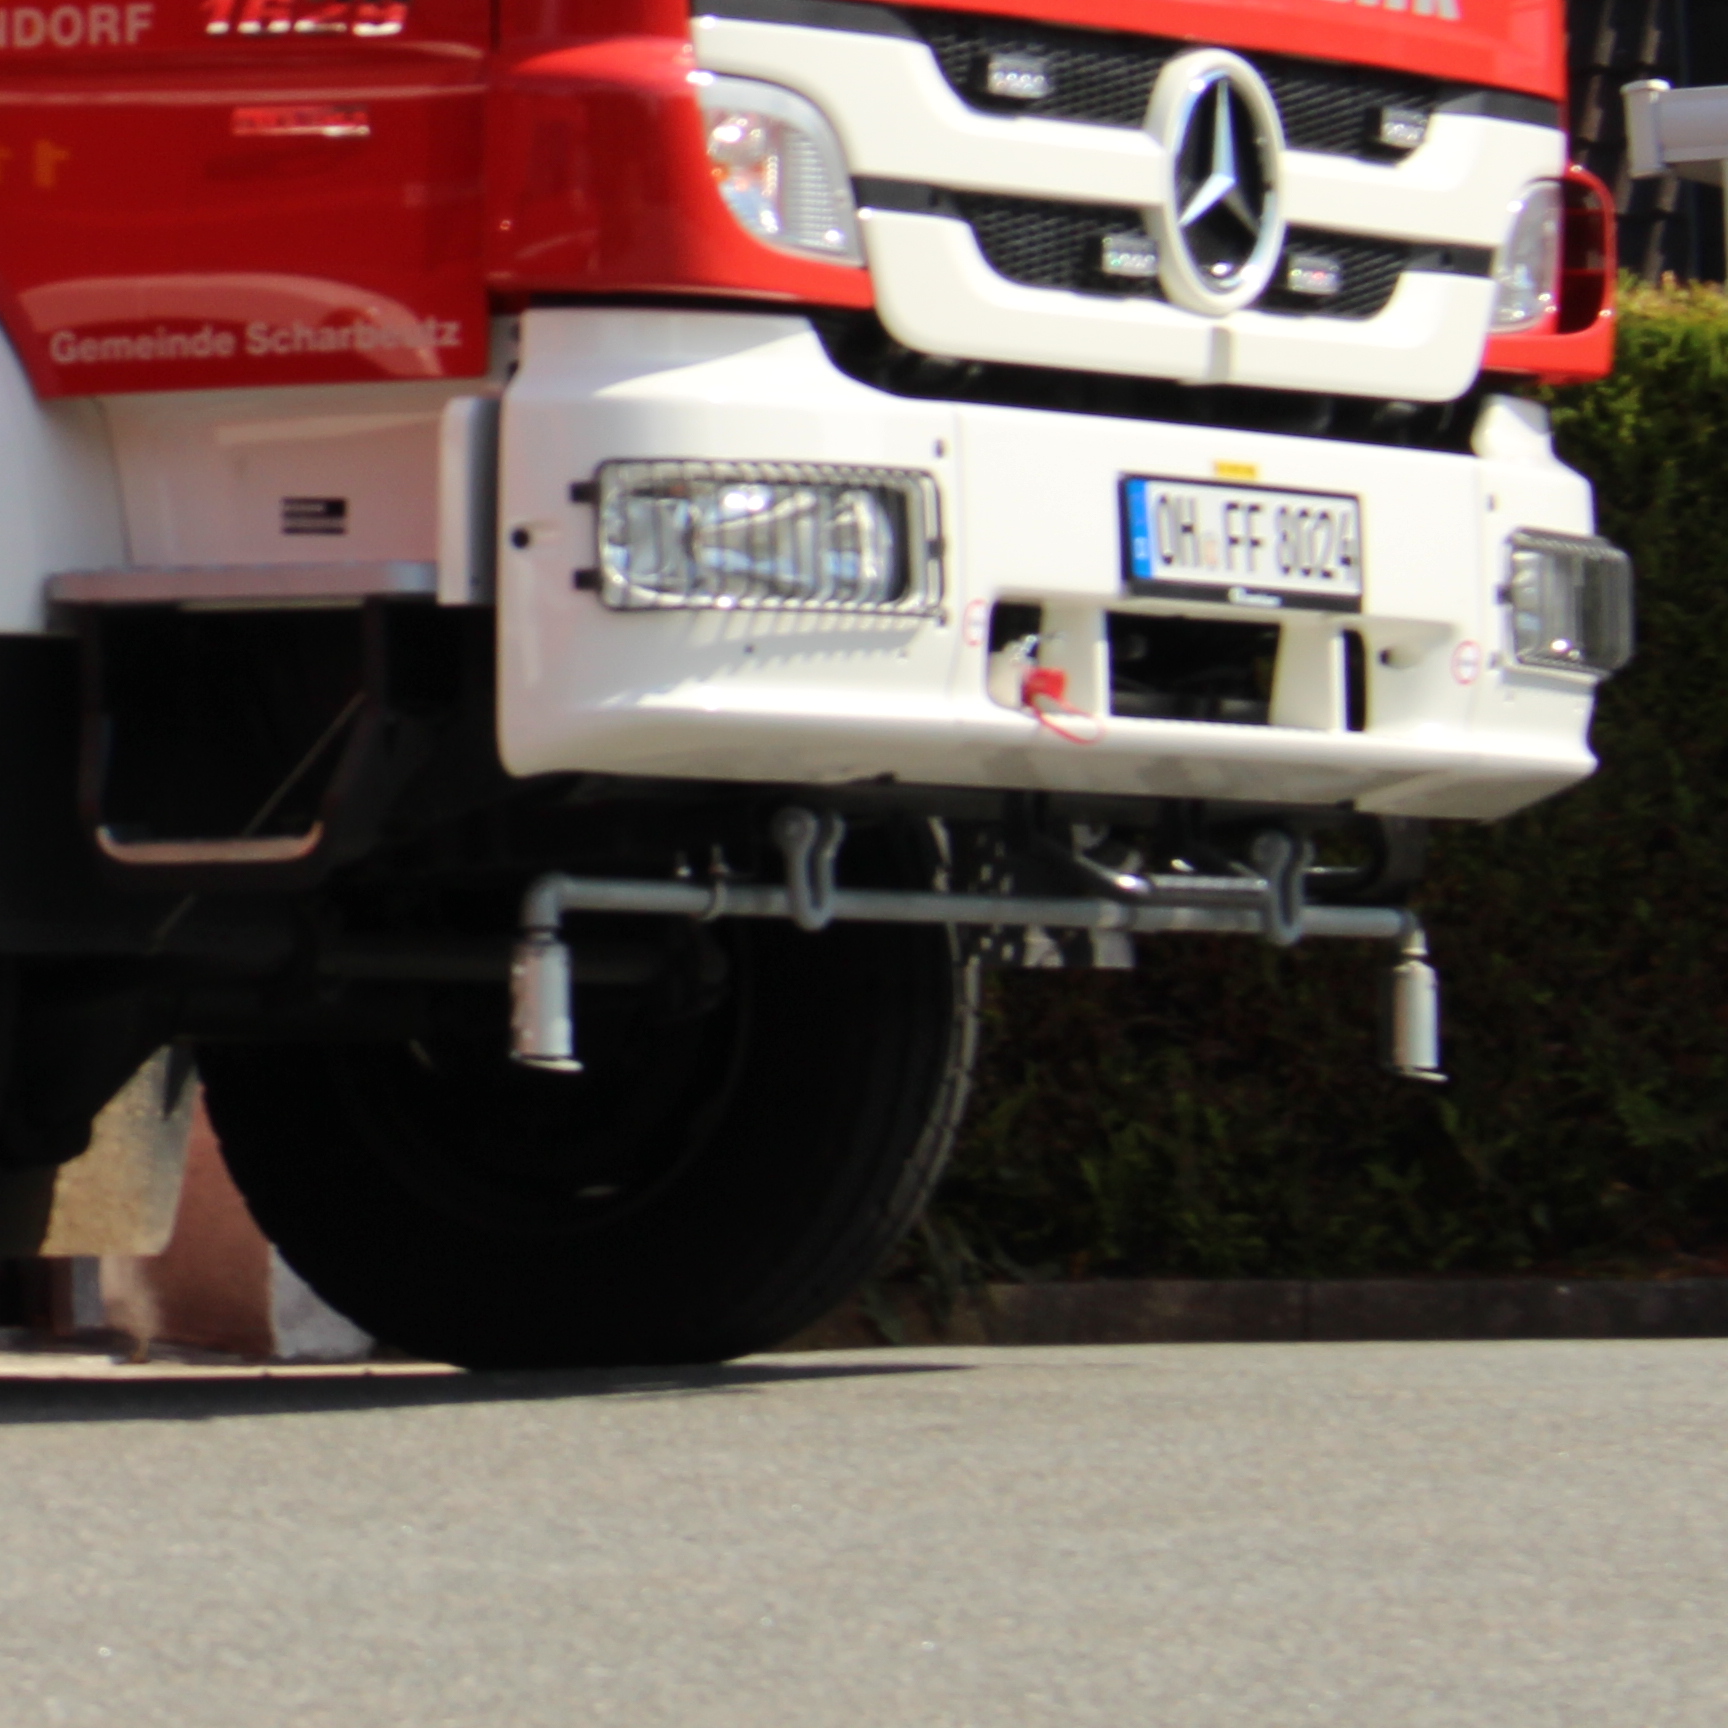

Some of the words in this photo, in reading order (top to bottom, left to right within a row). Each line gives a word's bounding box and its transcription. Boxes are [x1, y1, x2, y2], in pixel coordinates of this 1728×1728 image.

[49, 325, 237, 365] Gemeinde
[245, 316, 462, 357] Scharbtz
[1224, 501, 1264, 575] FF
